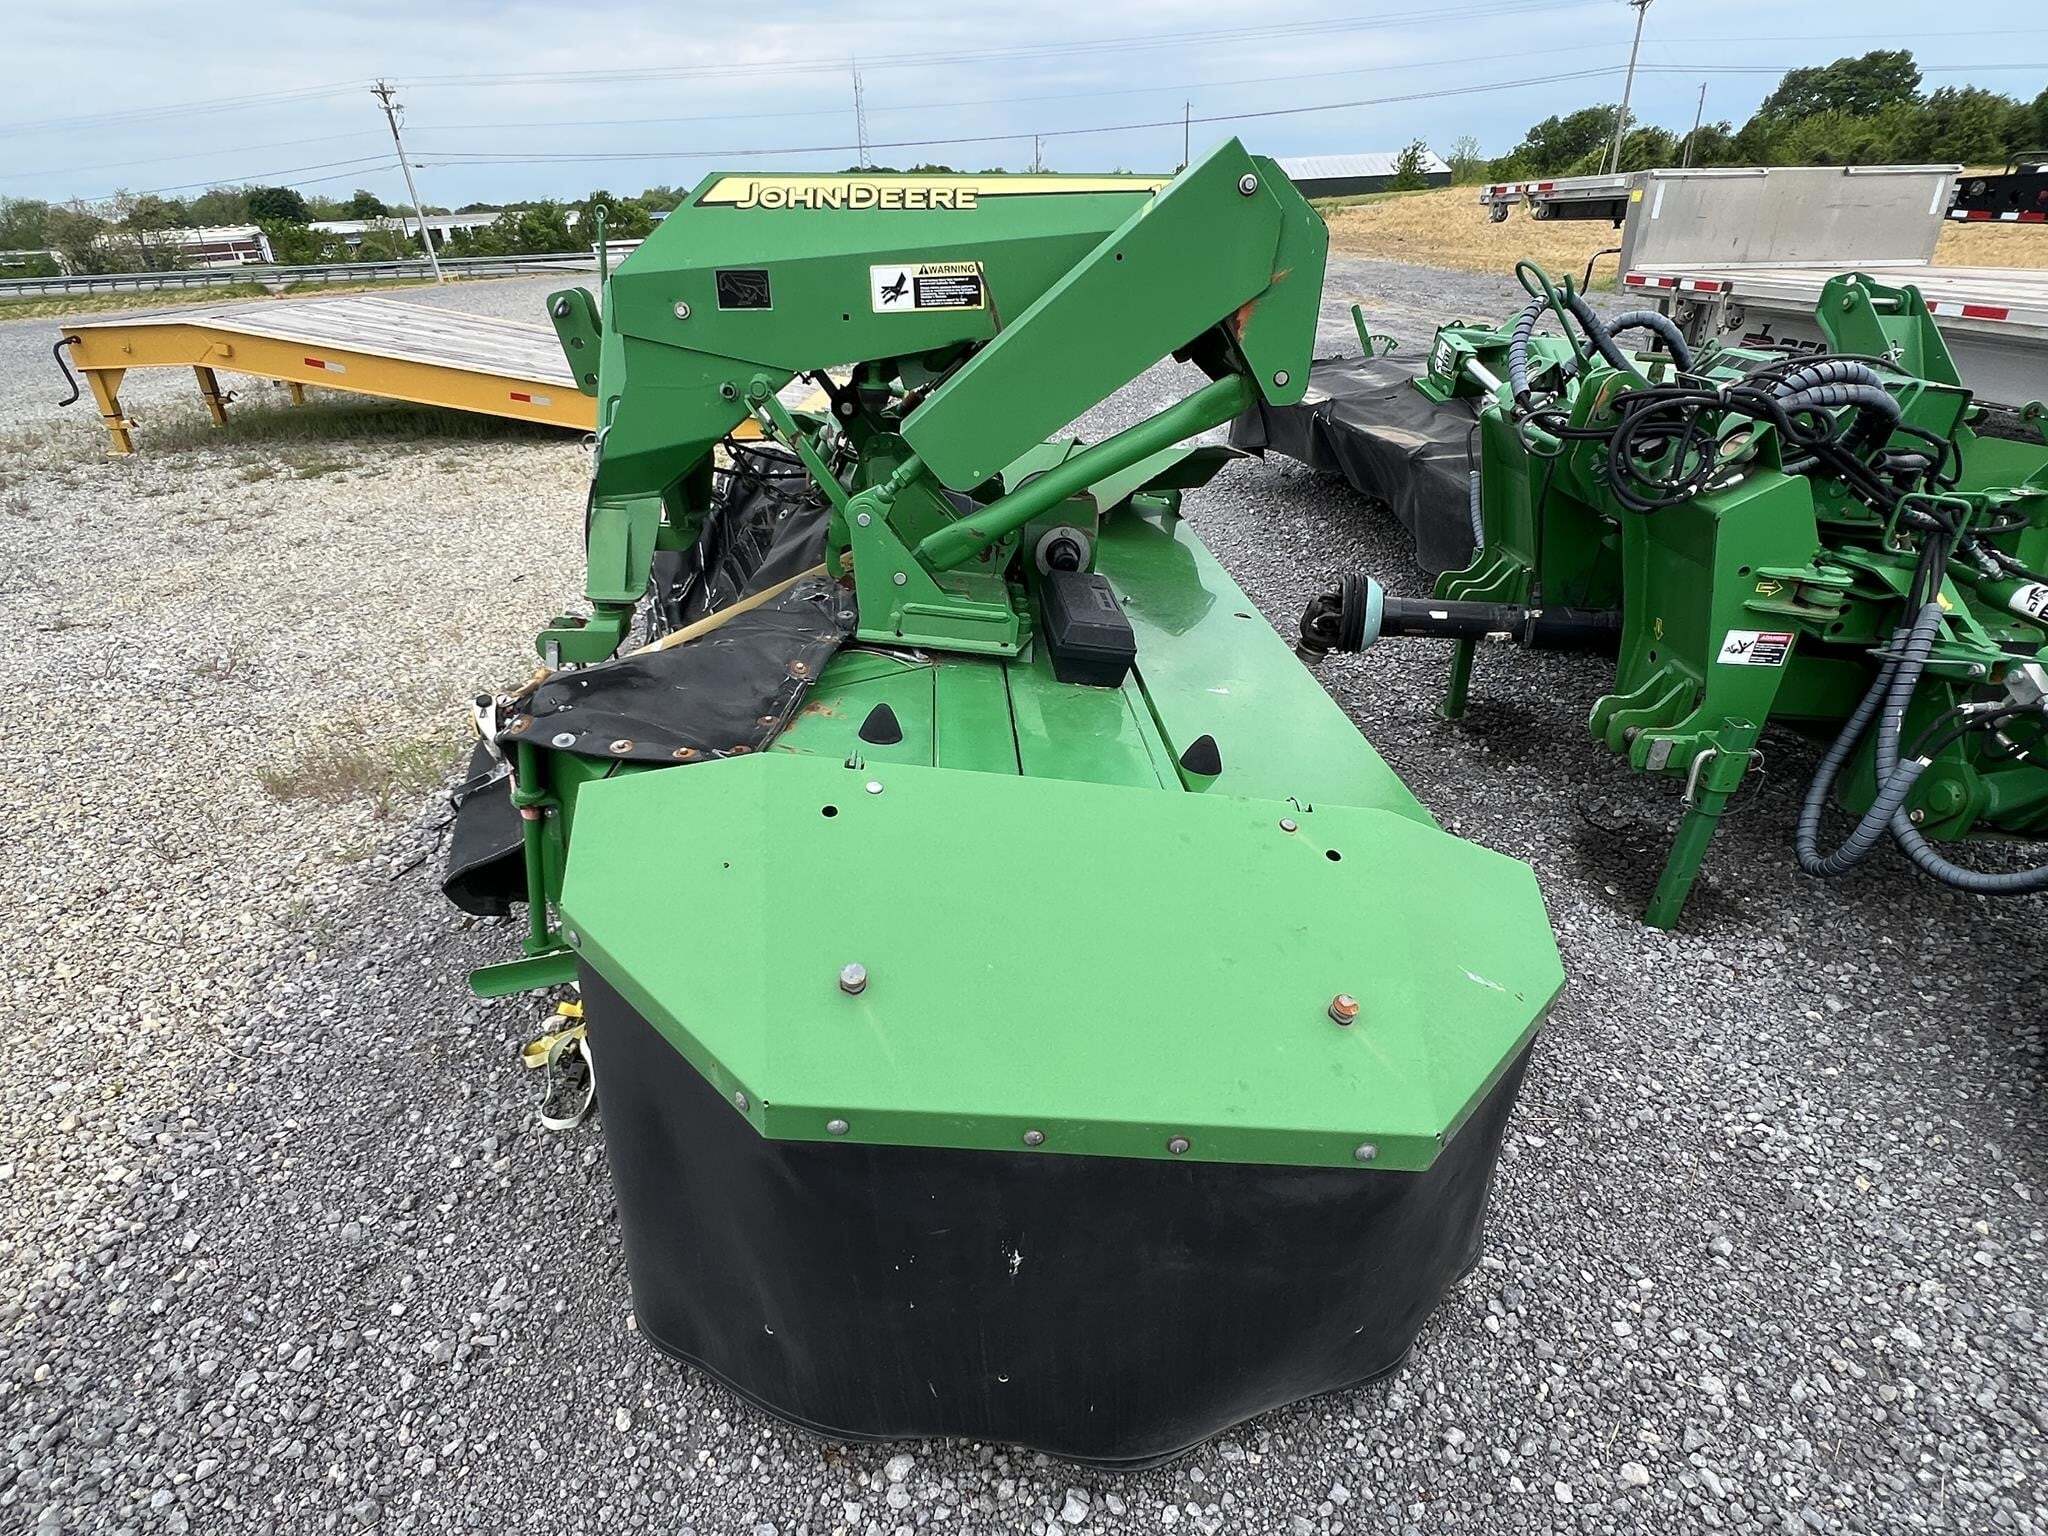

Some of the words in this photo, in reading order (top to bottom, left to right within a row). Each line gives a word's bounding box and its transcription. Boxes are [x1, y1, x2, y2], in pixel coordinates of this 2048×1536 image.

[735, 182, 843, 210] JOHN
[847, 182, 979, 210] DEERE
[928, 264, 976, 275] WARNING
